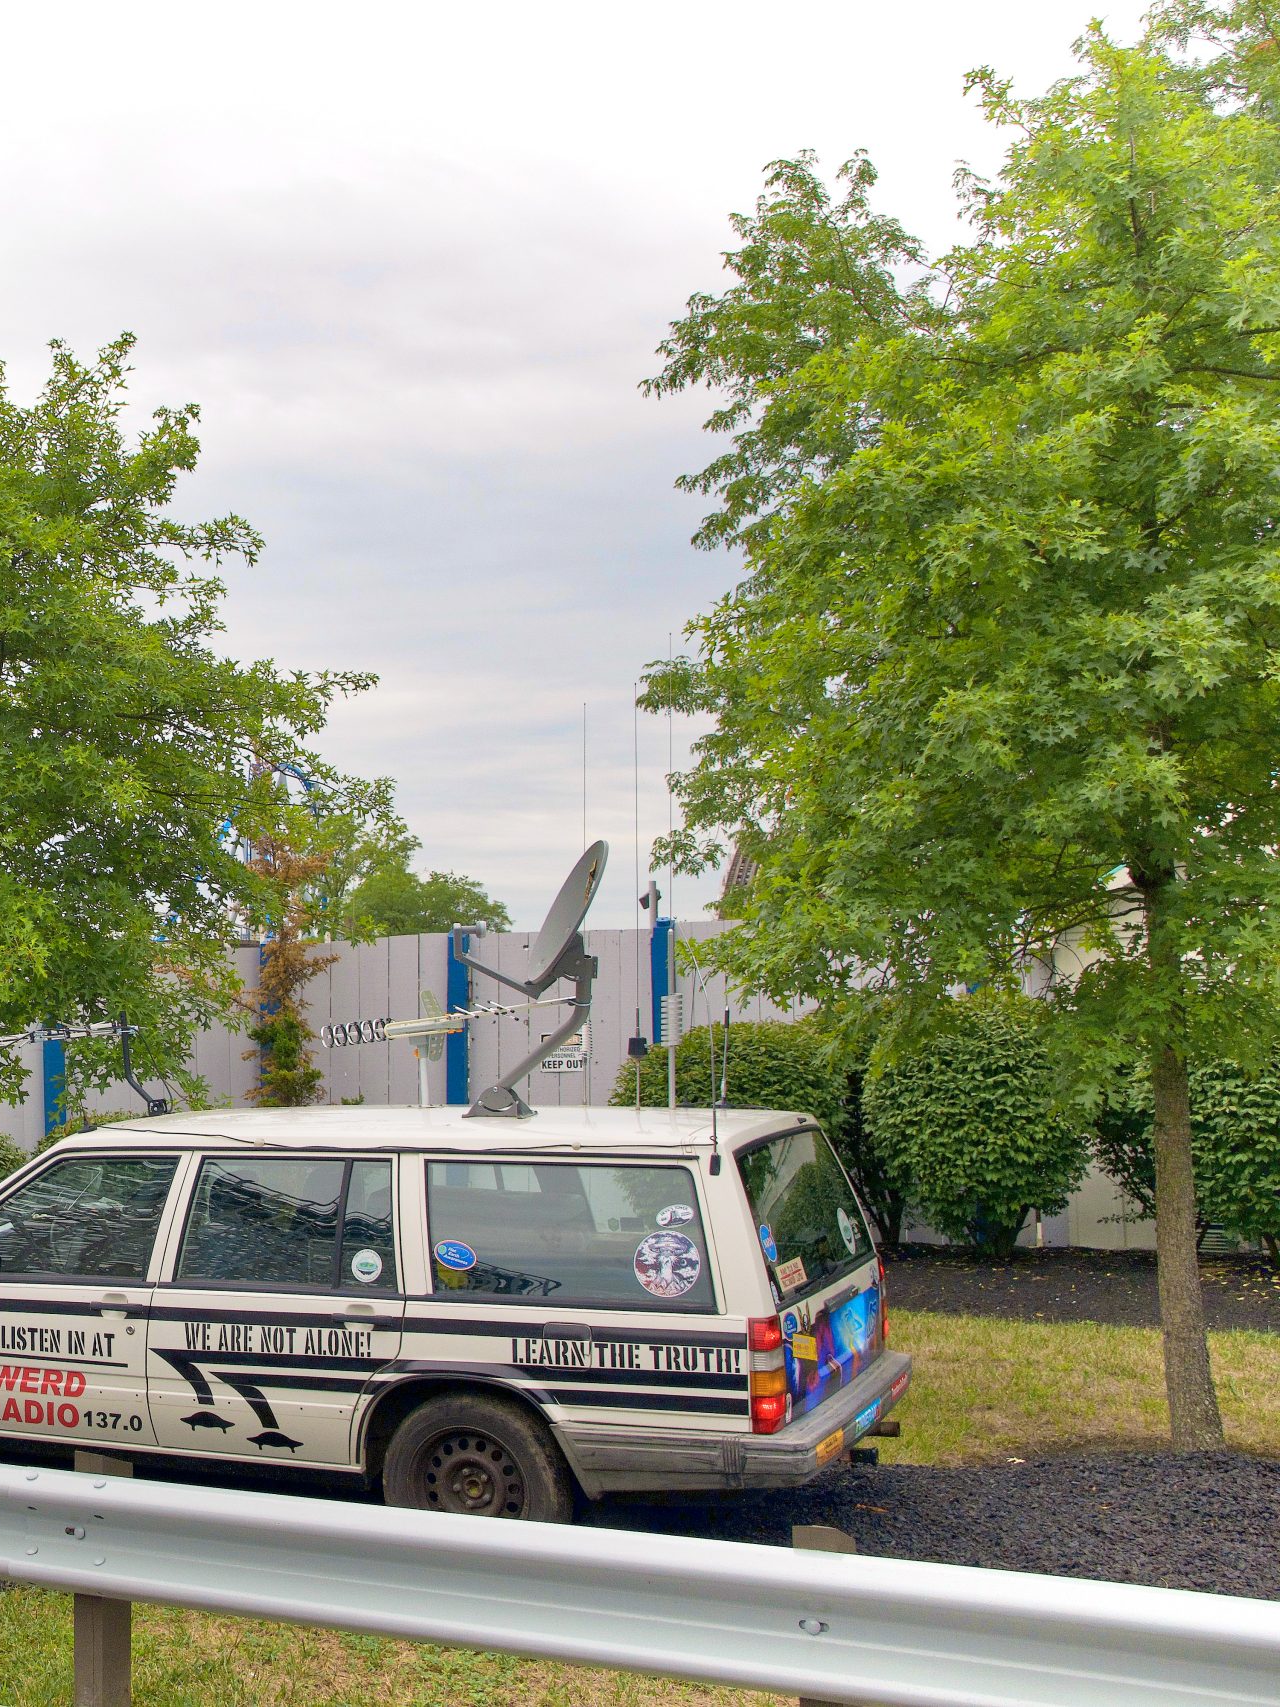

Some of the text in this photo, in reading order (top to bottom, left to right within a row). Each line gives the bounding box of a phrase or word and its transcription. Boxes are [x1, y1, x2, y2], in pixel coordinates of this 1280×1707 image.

[542, 1060, 583, 1069] KEEP OUT
[443, 1254, 468, 1265] Awareness
[1, 1325, 115, 1357] LISTEN IN AT
[184, 1322, 371, 1358] WE ARE NOT ALONE!
[512, 1338, 741, 1374] LEARN THE TRUTH!
[83, 1411, 143, 1432] 137.0
